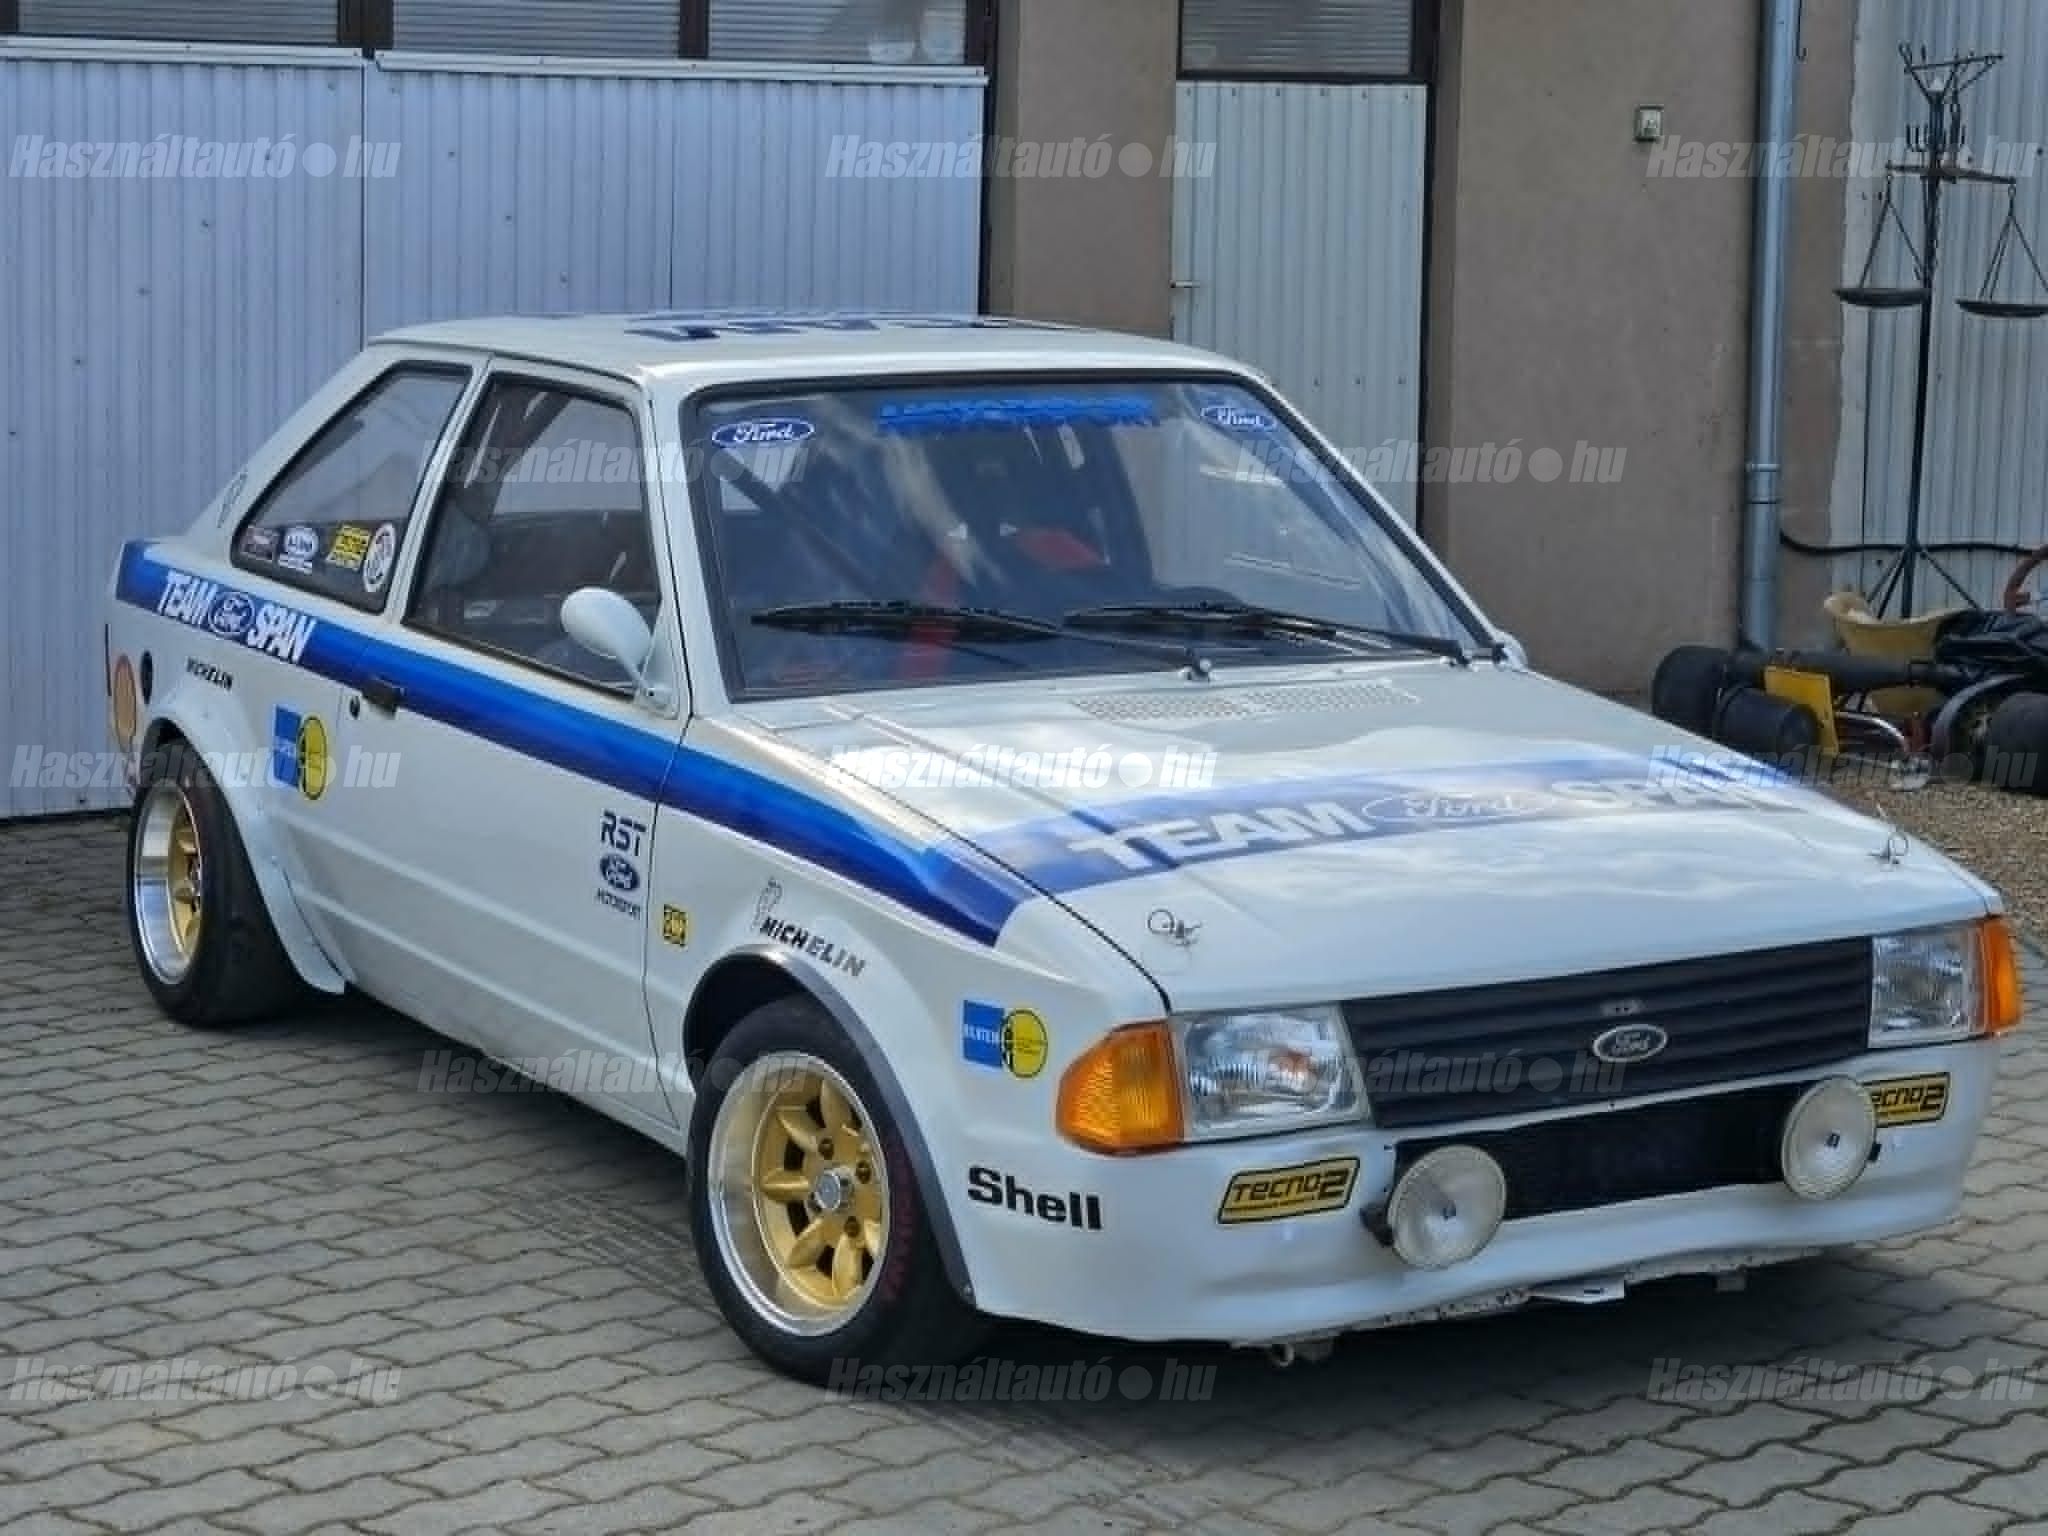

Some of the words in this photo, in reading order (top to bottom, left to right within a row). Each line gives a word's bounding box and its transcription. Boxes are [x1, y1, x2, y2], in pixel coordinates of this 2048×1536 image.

[733, 422, 794, 444] Ford
[157, 569, 219, 625] TEAM
[247, 603, 317, 666] SPAN
[599, 810, 647, 857] RST
[1066, 799, 1377, 872] TEAM
[760, 916, 866, 977] MICHELIN
[967, 1165, 1103, 1231] Shell
